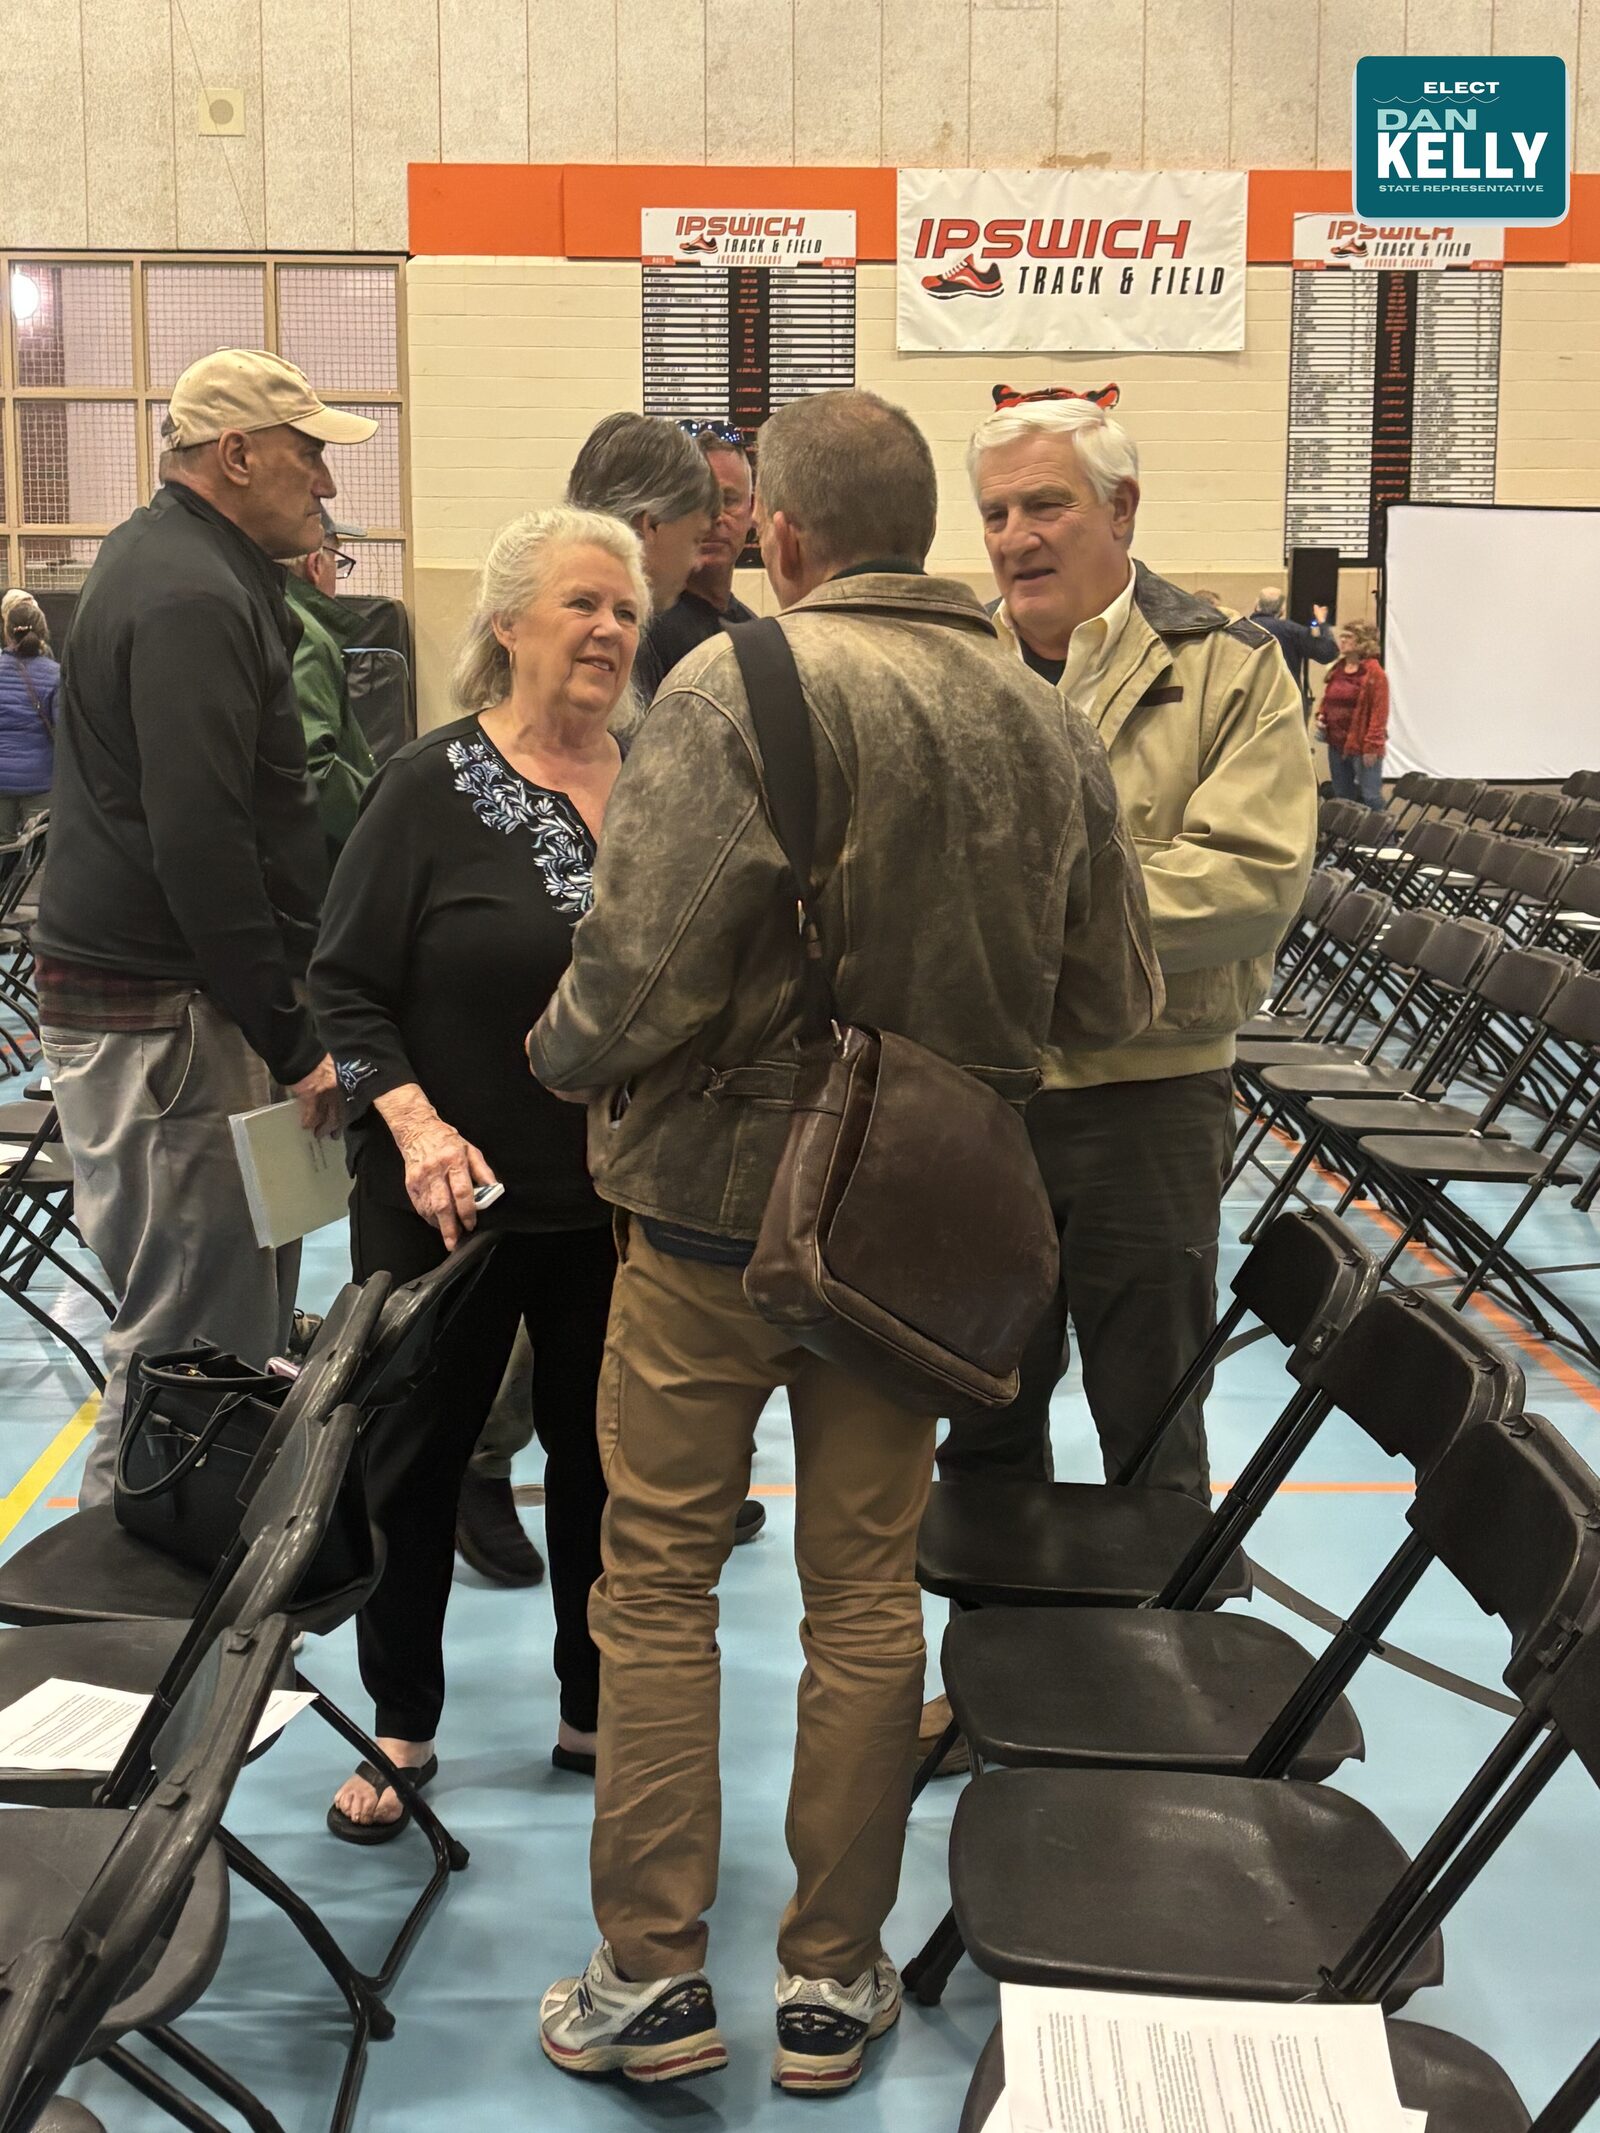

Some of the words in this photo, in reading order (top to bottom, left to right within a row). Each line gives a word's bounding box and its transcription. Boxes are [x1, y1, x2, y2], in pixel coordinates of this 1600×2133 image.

[675, 216, 806, 237] IPSWICH
[724, 238, 764, 253] TRACK
[772, 239, 779, 253] &
[787, 239, 822, 254] FIELD
[914, 218, 1192, 260] IPSWICH
[1374, 242, 1416, 256] TRACK
[1436, 243, 1472, 257] FIELD
[1018, 266, 1103, 295] TRACK
[1120, 266, 1134, 295] &
[1151, 266, 1226, 295] FIELD
